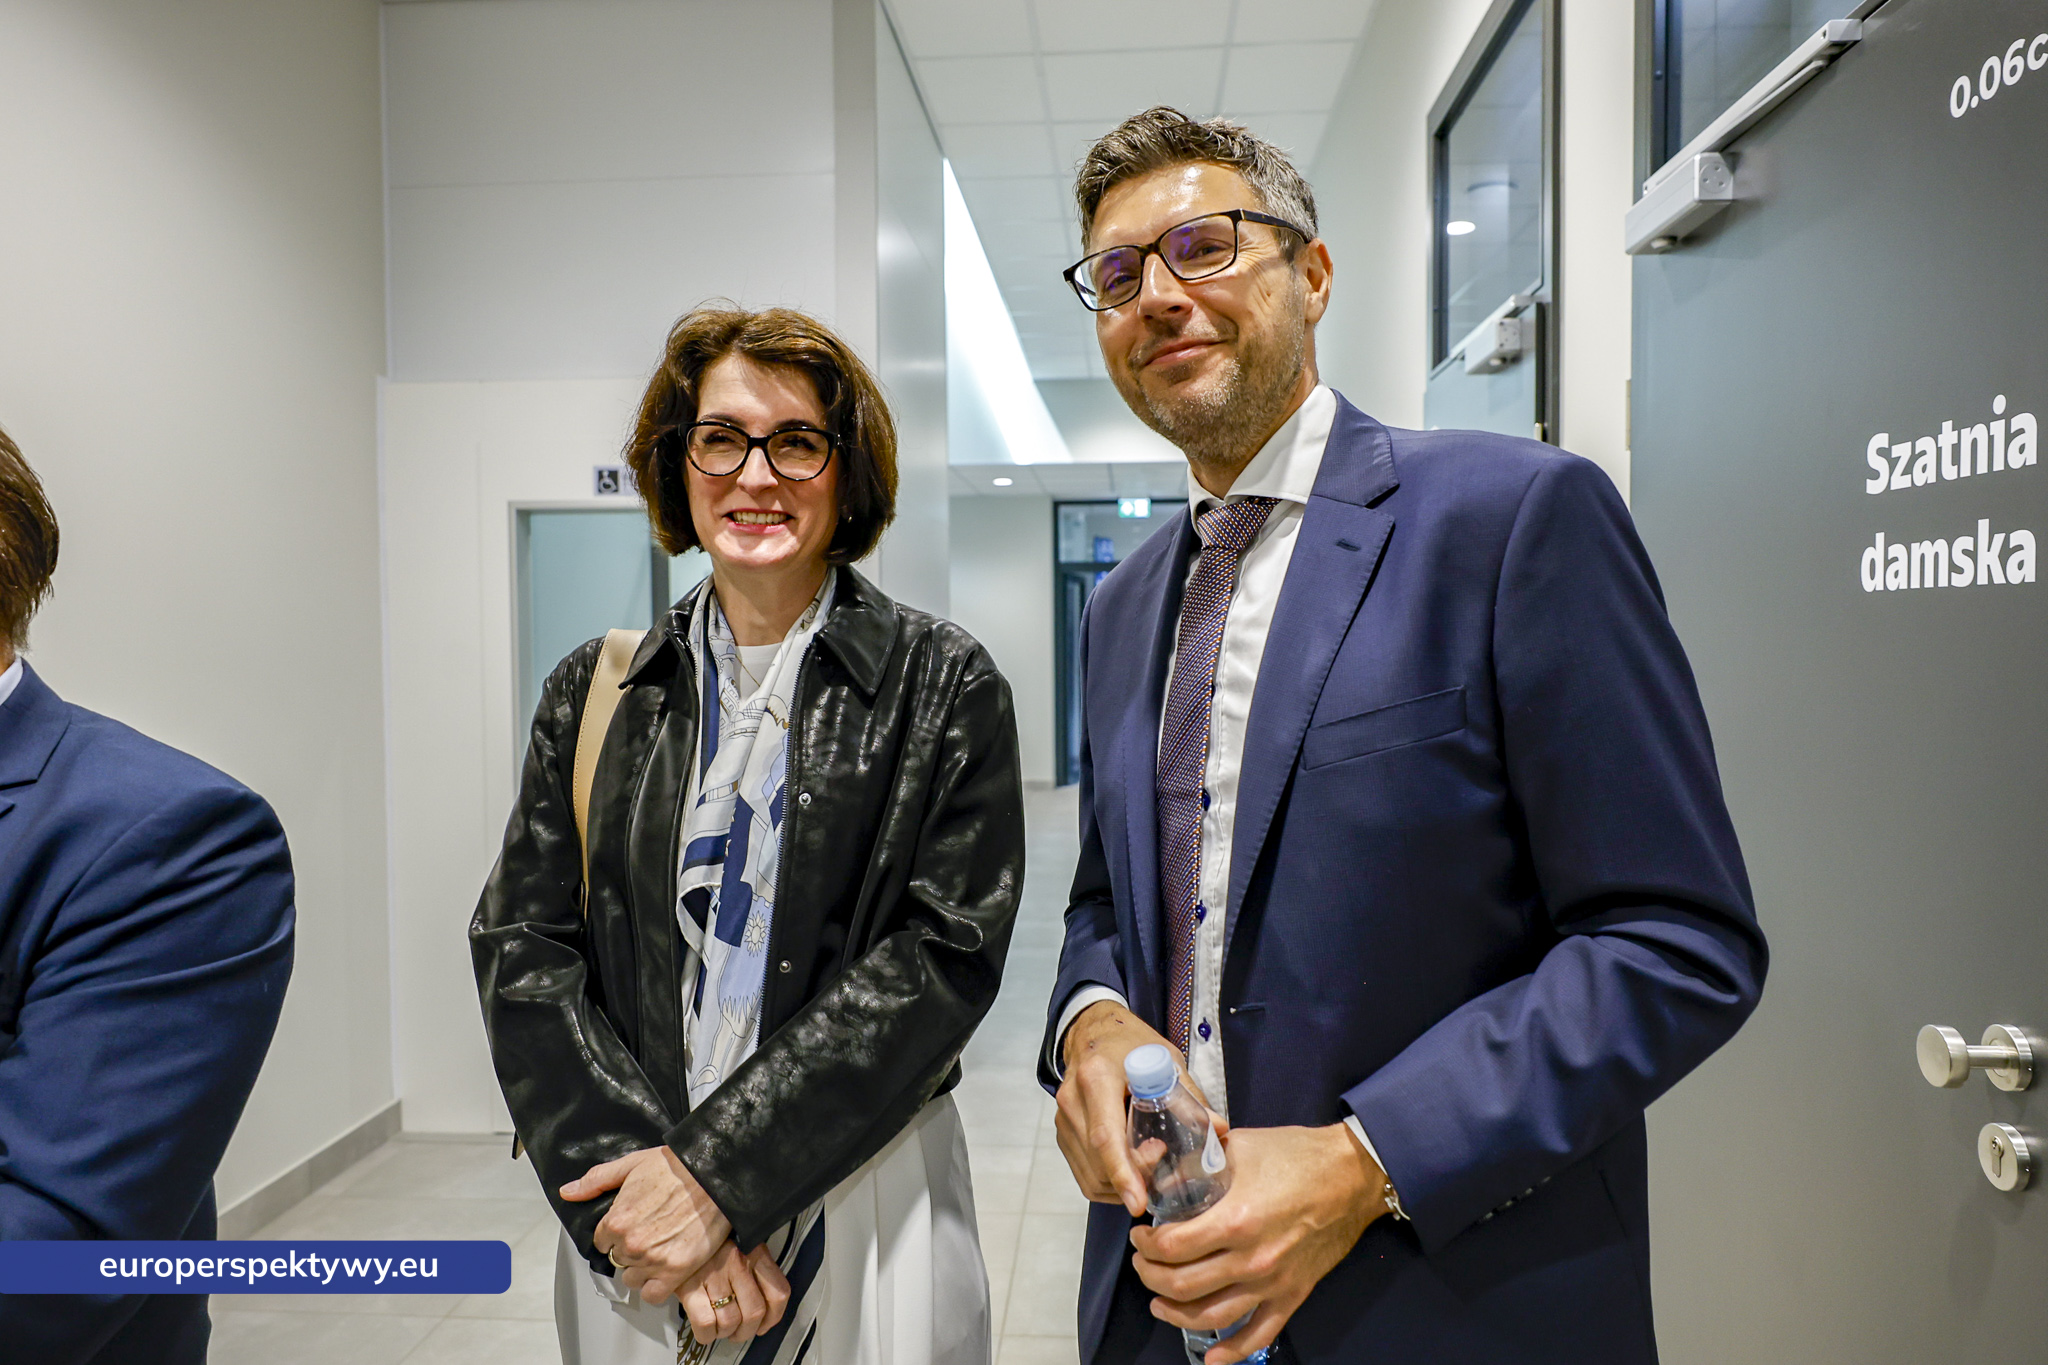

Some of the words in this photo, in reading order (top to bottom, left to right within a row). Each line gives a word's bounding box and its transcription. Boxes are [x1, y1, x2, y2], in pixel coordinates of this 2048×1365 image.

[1949, 33, 2048, 119] 0.06c
[1865, 394, 2038, 495] Szatnia
[1860, 518, 2037, 593] damska
